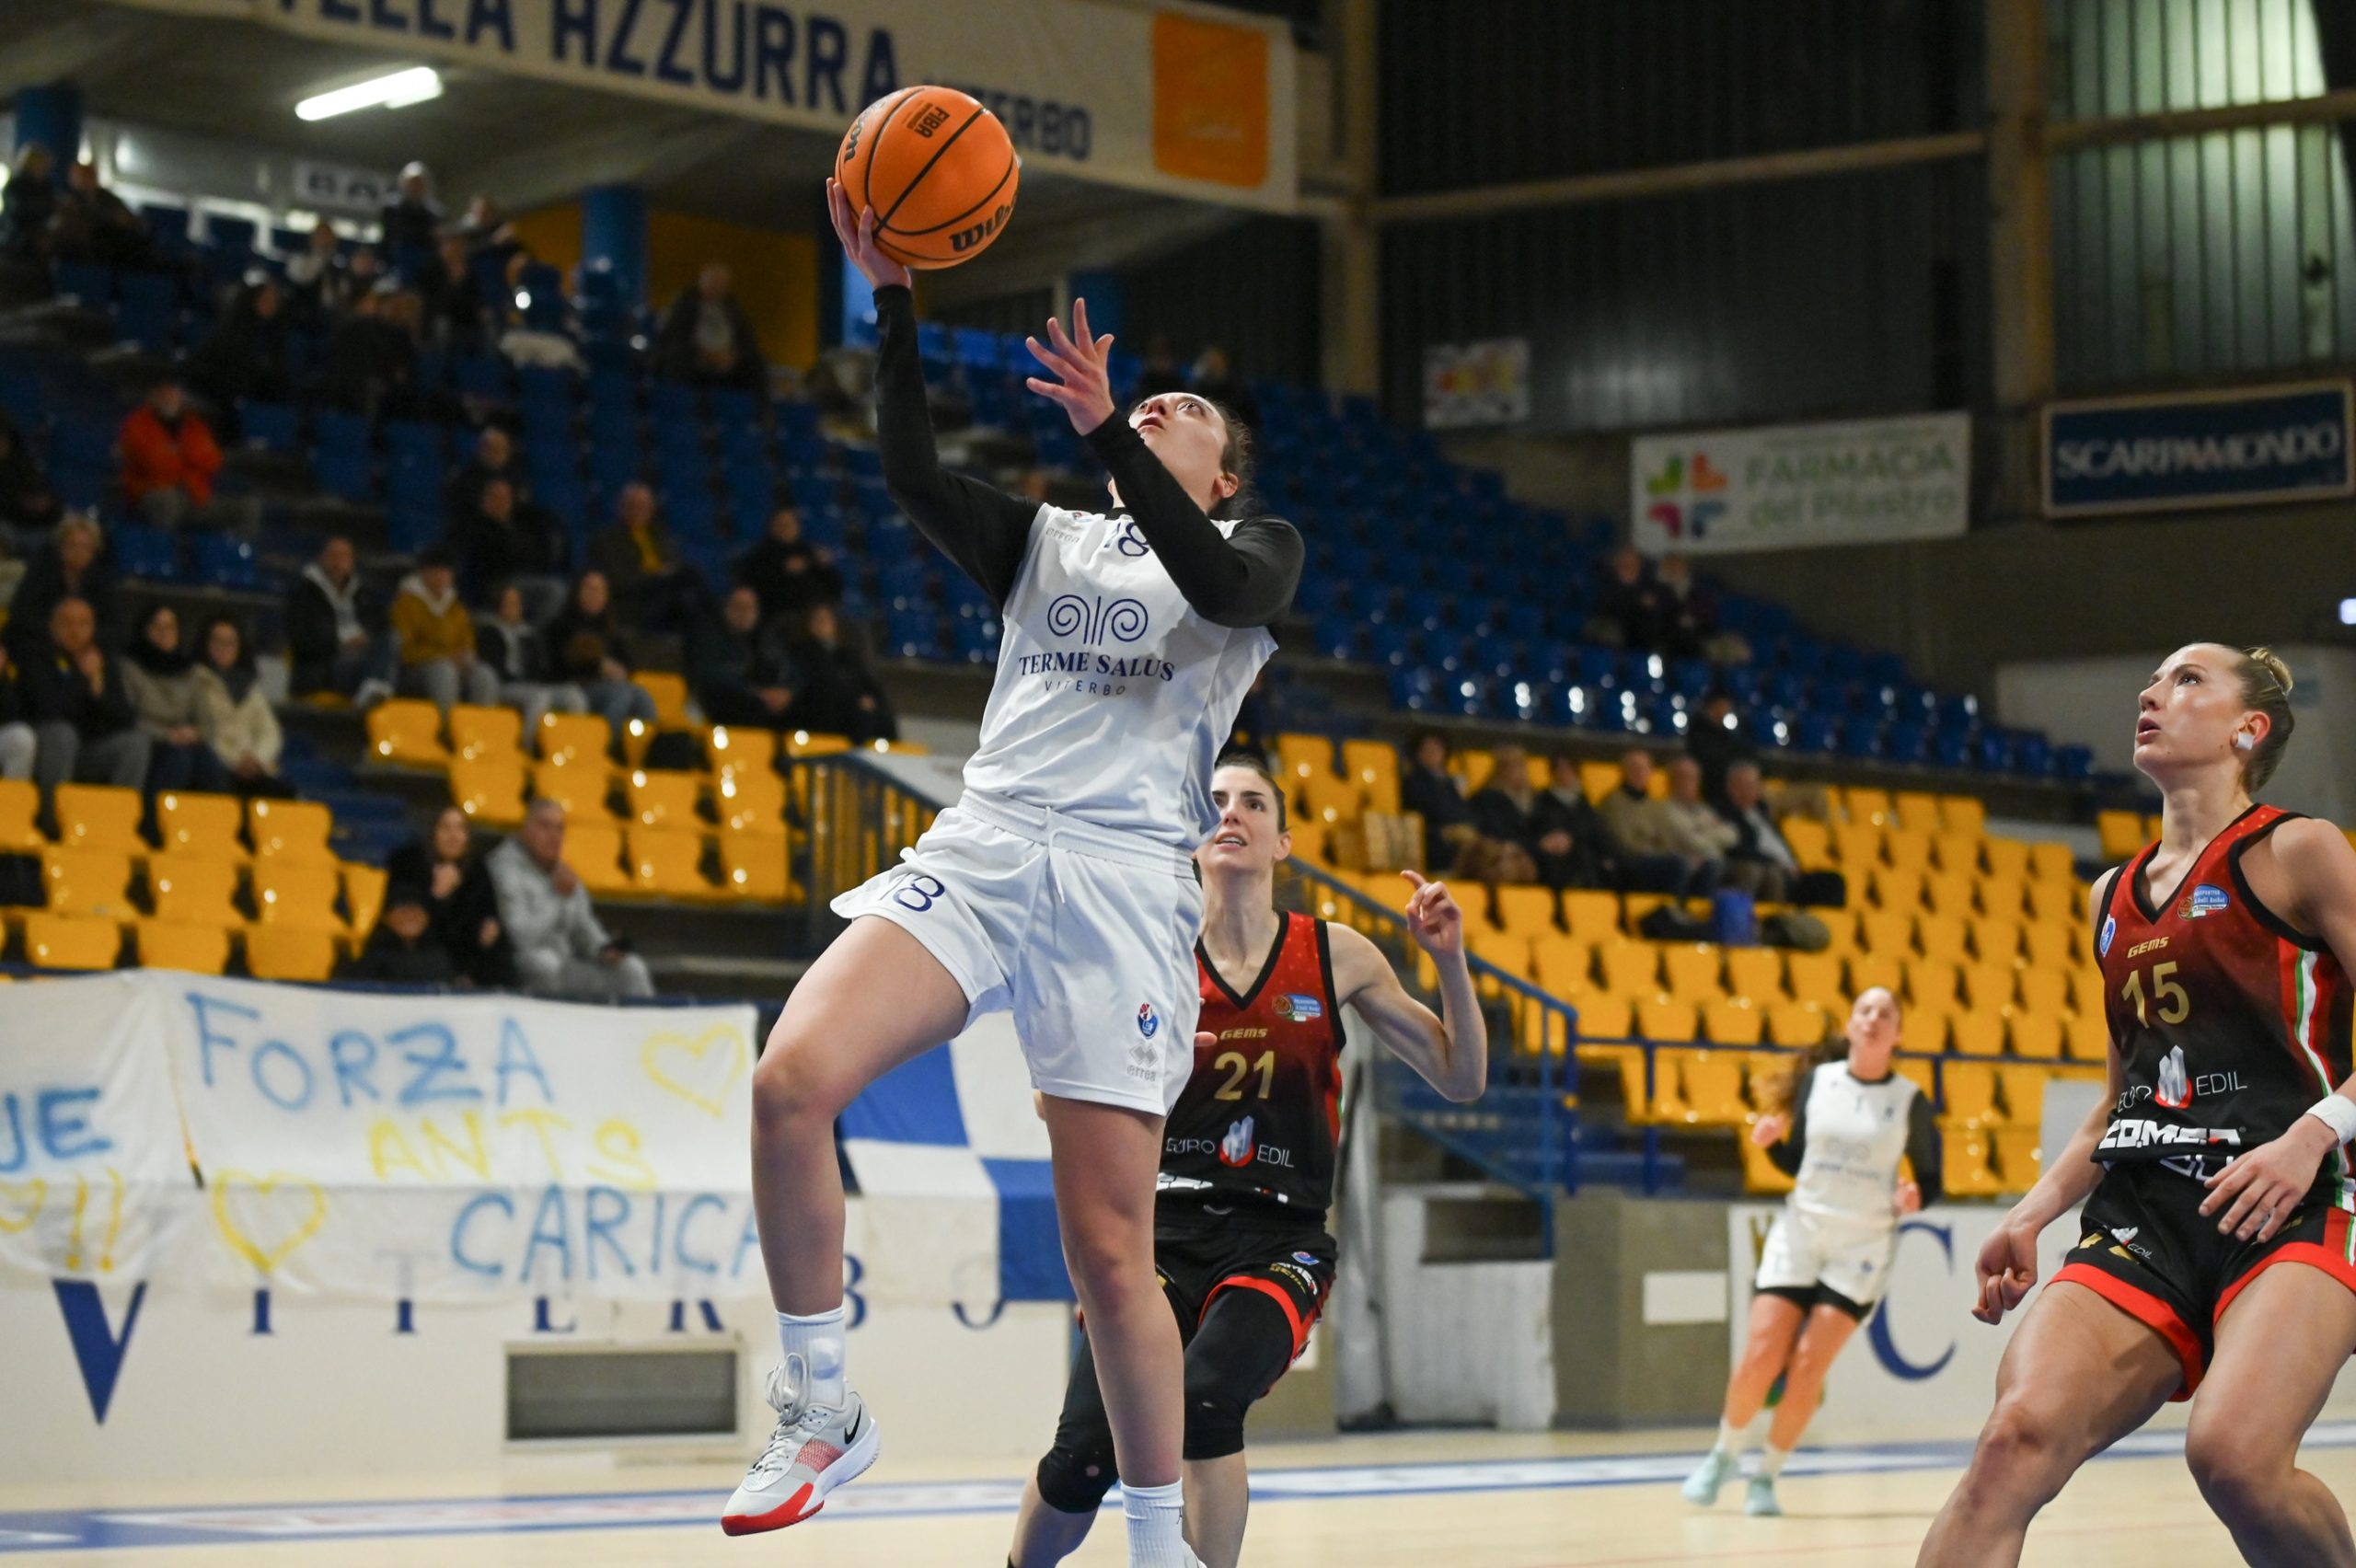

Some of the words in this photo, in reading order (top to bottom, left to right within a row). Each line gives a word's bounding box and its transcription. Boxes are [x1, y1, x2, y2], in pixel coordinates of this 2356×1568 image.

[914, 106, 951, 138] FIBA
[1746, 442, 1956, 486] FARMACIA
[2057, 421, 2342, 479] SCARPAMONDO
[1019, 651, 1090, 676] TERME
[1096, 653, 1175, 682] SALUS
[1045, 679, 1126, 697] VITERBO
[2127, 936, 2169, 959] GEMS
[2121, 961, 2189, 1029] 15
[1219, 1028, 1268, 1041] GEMS
[186, 992, 554, 1110] FORZA
[1214, 1050, 1275, 1101] 21
[2196, 1070, 2248, 1097] EDIL
[370, 1110, 658, 1189] ANTS
[1256, 1144, 1295, 1169] EDIL
